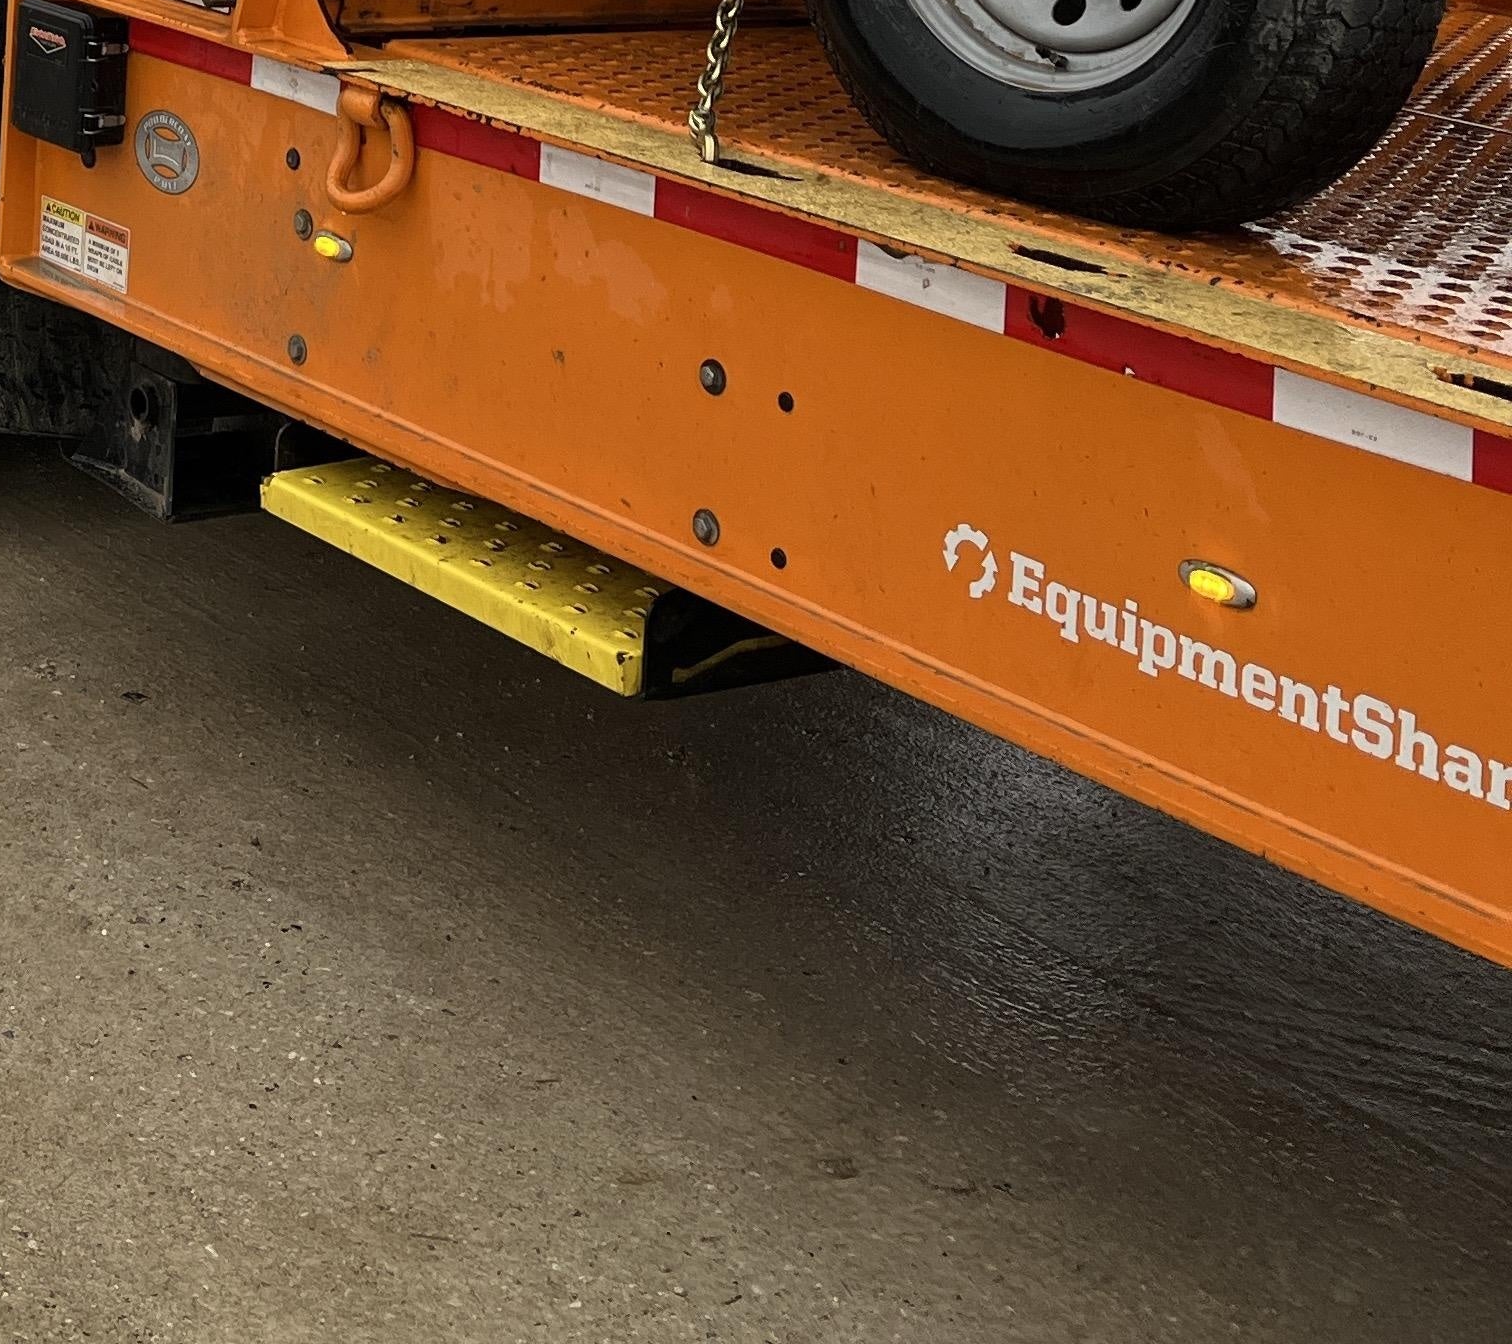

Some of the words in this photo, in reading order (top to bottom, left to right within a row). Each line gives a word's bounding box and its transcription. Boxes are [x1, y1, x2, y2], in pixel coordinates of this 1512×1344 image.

[51, 203, 81, 223] CAUTION
[42, 224, 80, 245] CONCENTRATED
[95, 223, 126, 244] WARNING
